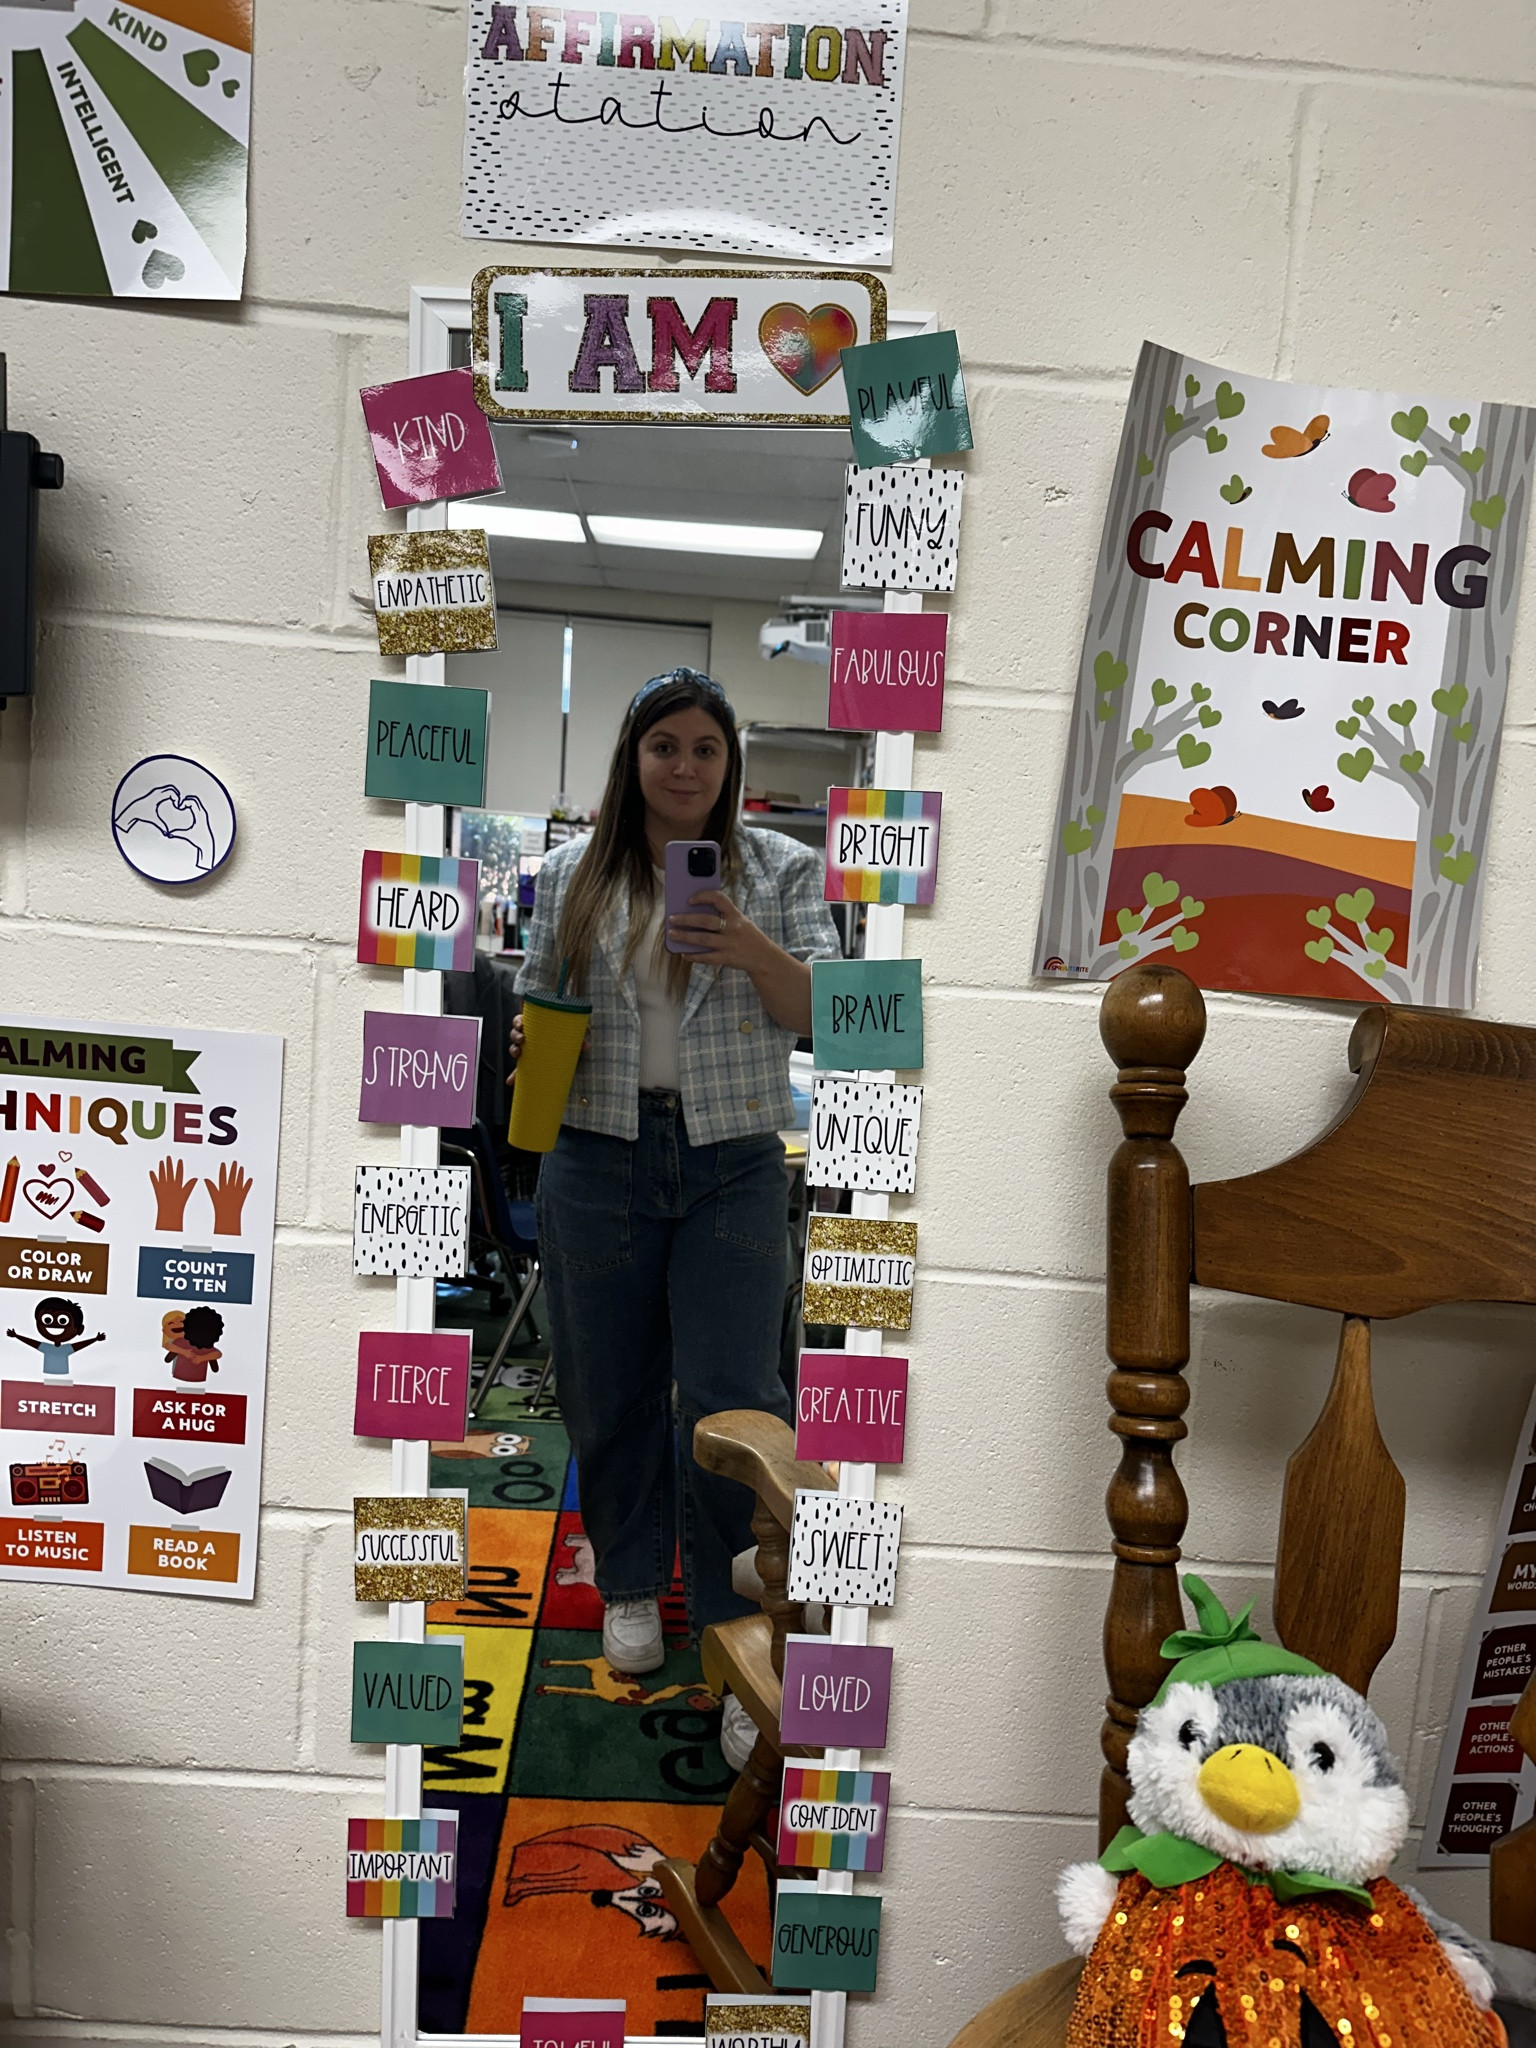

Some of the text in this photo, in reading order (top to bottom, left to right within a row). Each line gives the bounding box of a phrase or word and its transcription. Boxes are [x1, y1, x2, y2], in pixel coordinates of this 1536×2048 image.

[107, 7, 168, 52] KIND
[481, 5, 888, 86] AFFIRMATION
[56, 61, 135, 204] INTELLIGENT
[494, 292, 738, 394] I AM
[858, 373, 955, 420] PLAYFUL
[393, 411, 466, 463] KIND
[856, 503, 947, 550] FUNNY
[1126, 509, 1491, 609] CALMING
[377, 573, 487, 609] EMPATHETIC
[1173, 602, 1411, 665] CORNER
[834, 648, 944, 687] FABULOUS
[377, 720, 476, 765] PEACEFUL
[840, 823, 929, 867] BRIGHT
[377, 885, 460, 931] HEARD
[832, 994, 905, 1034] BRAVE
[365, 1046, 468, 1092] STRONG
[816, 1112, 912, 1157] UNIQUE
[361, 1203, 461, 1237] ENERGETIC
[20, 1249, 82, 1266] COLOR
[165, 1259, 228, 1276] COUNT
[811, 1255, 912, 1286] OPTIMISTIC
[7, 1266, 93, 1284] OR DRAW
[163, 1276, 227, 1293] TO TEN
[373, 1363, 452, 1406] FIERCE
[17, 1400, 97, 1418] STRETCH
[152, 1400, 227, 1418] ASK FOR
[799, 1387, 903, 1426] CREATIVE
[162, 1416, 216, 1433] A HUG
[5, 1543, 89, 1561] TO MUSIC
[18, 1528, 77, 1544] LISTEN
[153, 1537, 216, 1555] READ A
[358, 1534, 458, 1562] SUCCESSFUL
[803, 1529, 884, 1571] SWEET
[158, 1555, 208, 1571] BOOK
[1507, 1581, 1536, 1591] WORD
[1486, 1653, 1531, 1668] PEOPLE'S
[1494, 1643, 1527, 1655] OTHER
[1483, 1665, 1531, 1679] MISTAKES
[363, 1673, 452, 1712] VALUED
[799, 1674, 871, 1712] LOVED
[1469, 1744, 1514, 1755] ACTIONS
[1471, 1733, 1516, 1743] PEOPLE
[790, 1804, 877, 1832] CONFIDENT
[1453, 1812, 1501, 1823] PEOPLE'S
[1462, 1801, 1497, 1811] OTHER
[1448, 1823, 1503, 1834] THOUGHTS
[349, 1853, 451, 1881] IMPORTANT
[778, 1923, 878, 1957] GENEROUS
